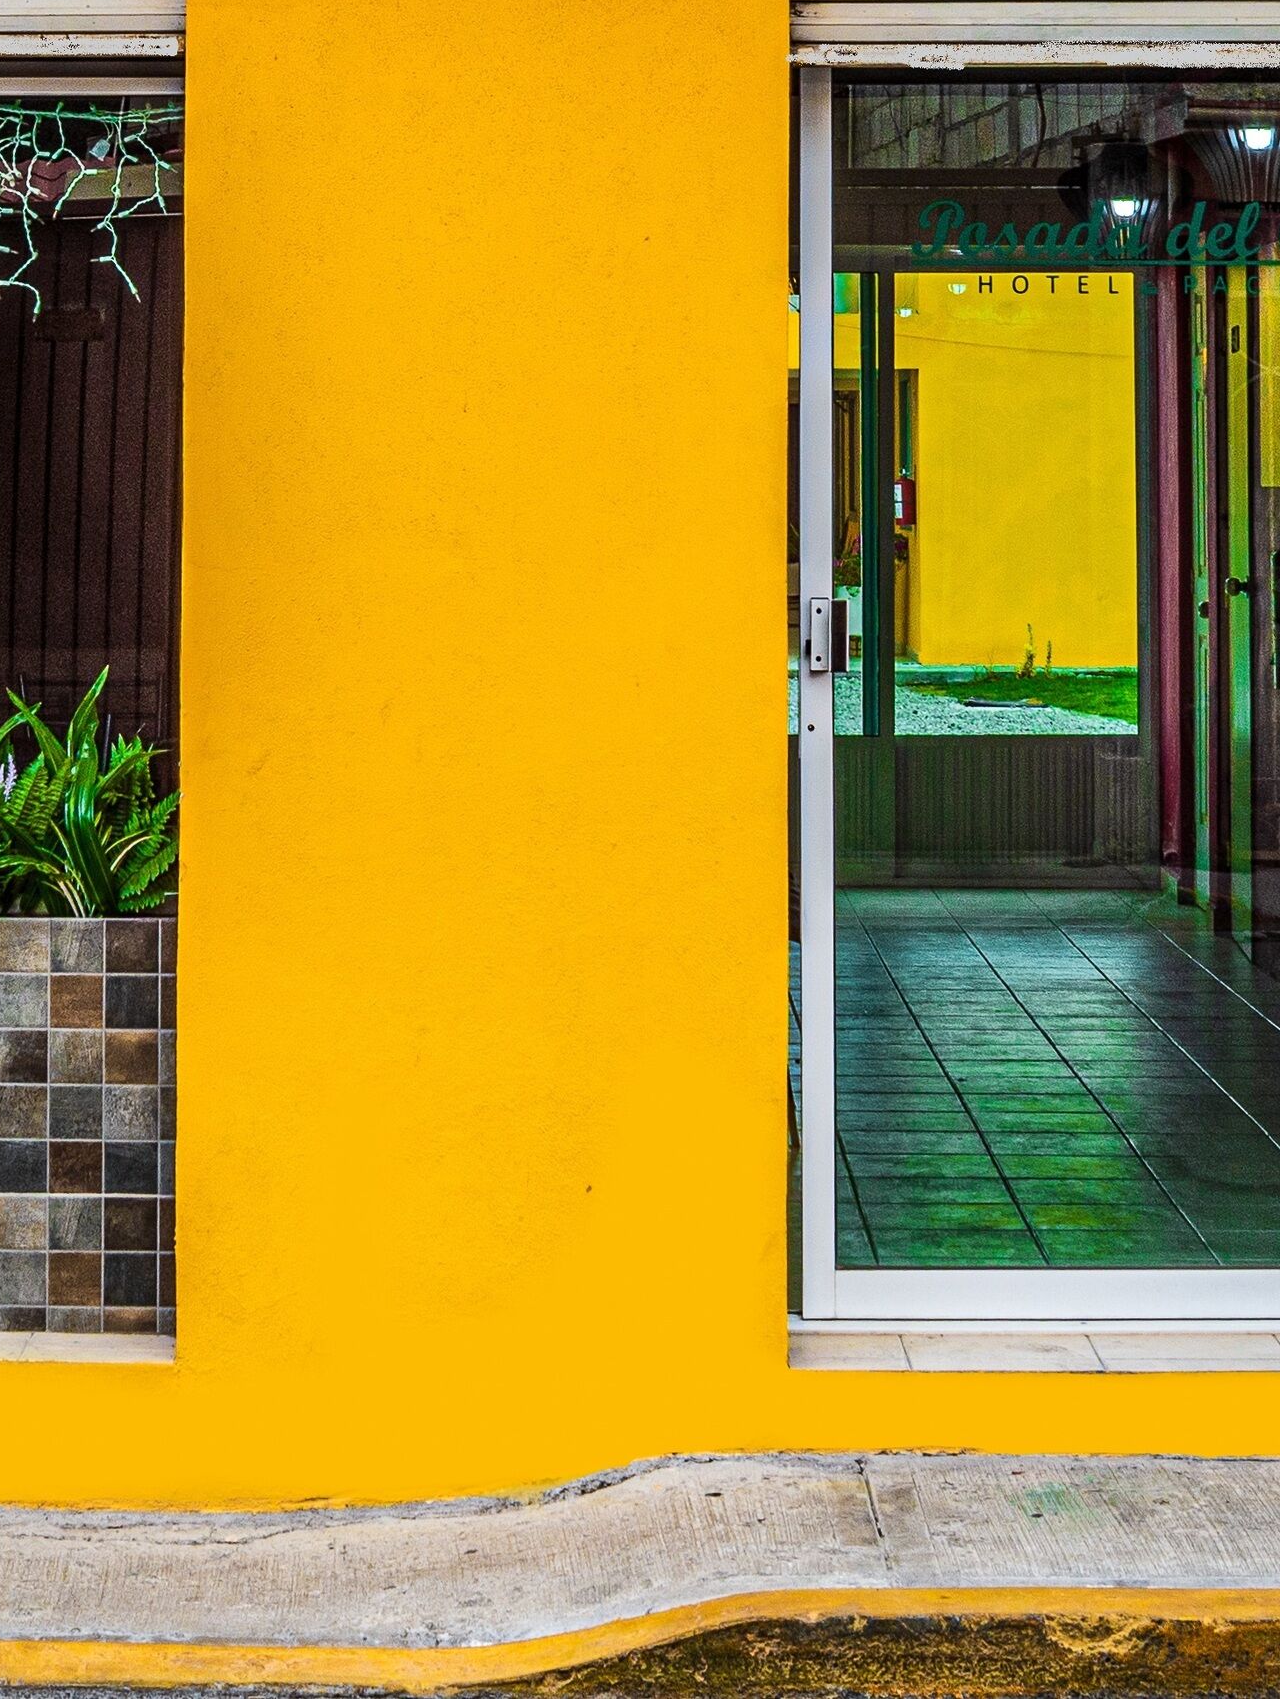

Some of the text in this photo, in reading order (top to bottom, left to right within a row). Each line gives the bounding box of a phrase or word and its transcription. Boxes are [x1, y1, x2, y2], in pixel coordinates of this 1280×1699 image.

[911, 198, 1148, 257] Posada
[1166, 201, 1262, 259] del
[978, 275, 1119, 295] HOTEL
